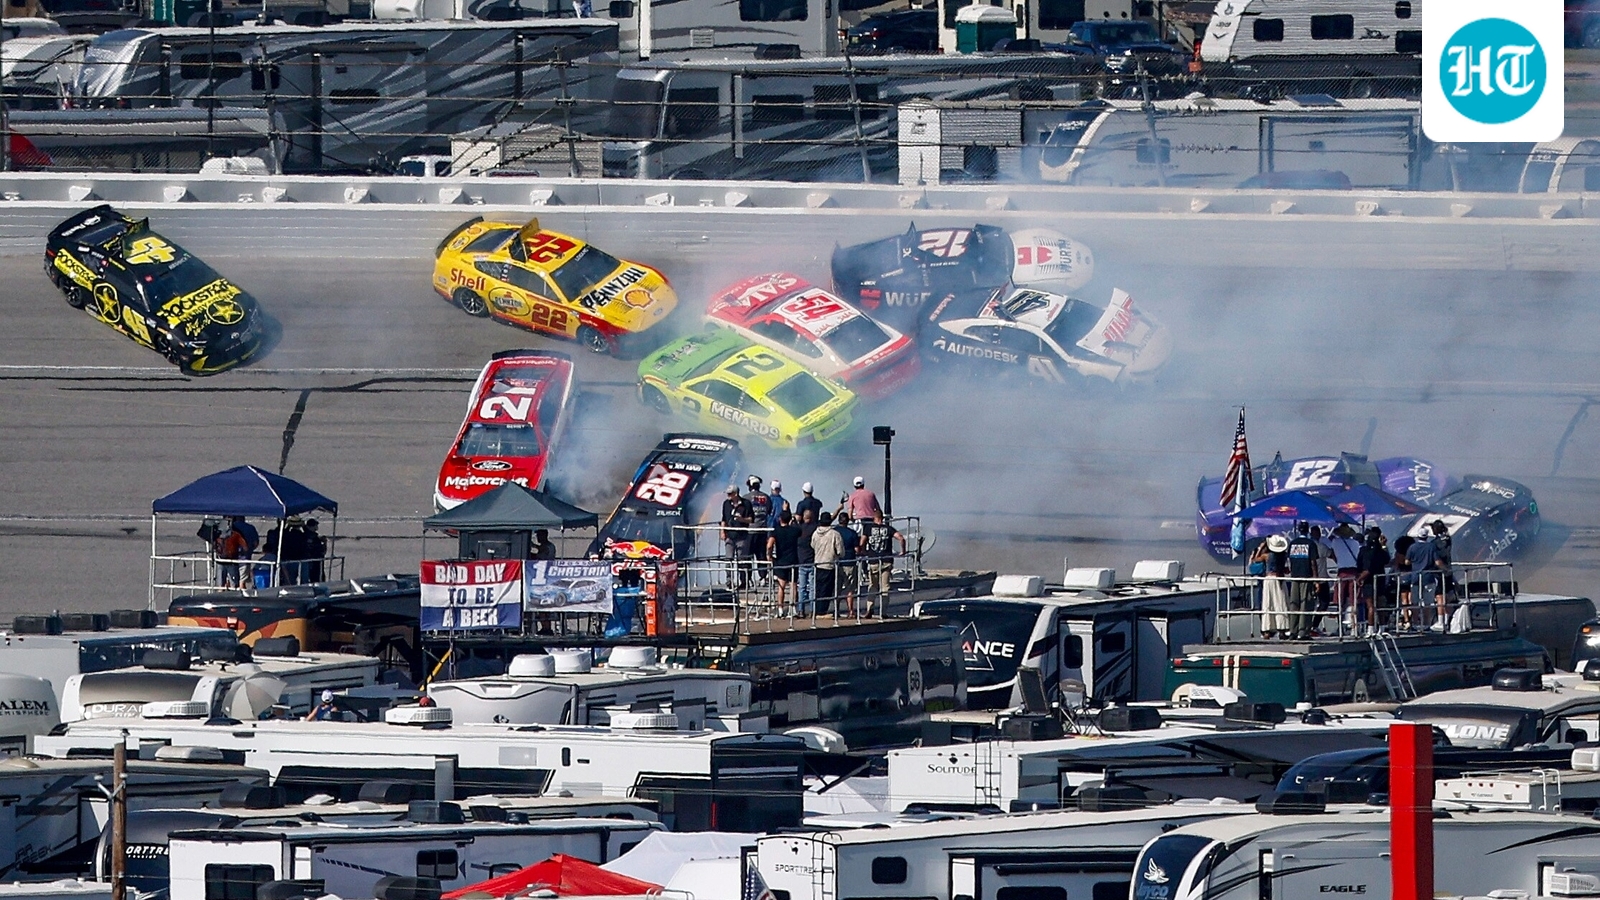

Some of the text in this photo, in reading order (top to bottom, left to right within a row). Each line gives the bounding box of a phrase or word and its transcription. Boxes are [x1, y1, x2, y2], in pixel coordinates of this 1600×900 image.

[523, 234, 576, 263] 22
[918, 231, 971, 257] 12
[450, 267, 487, 291] Shell
[531, 303, 568, 331] 22
[784, 293, 844, 321] 54
[946, 342, 1019, 364] AUTODESK
[723, 353, 784, 380] 2
[479, 387, 536, 421] 21
[710, 401, 780, 439] MENARDS
[1284, 460, 1339, 489] 23
[434, 563, 507, 584] BAD DAY
[531, 560, 548, 585] 1
[547, 565, 609, 577] CHASTAIN
[447, 587, 495, 605] TO BE
[441, 608, 499, 628] A BEER
[961, 640, 1016, 659] ANCE
[0, 699, 50, 711] ALEM
[92, 703, 142, 714] DURA
[1433, 724, 1511, 741] LONE
[125, 845, 169, 856] ORTTR
[774, 864, 817, 874] SPORTTRE
[1319, 884, 1367, 894] EAGLE
